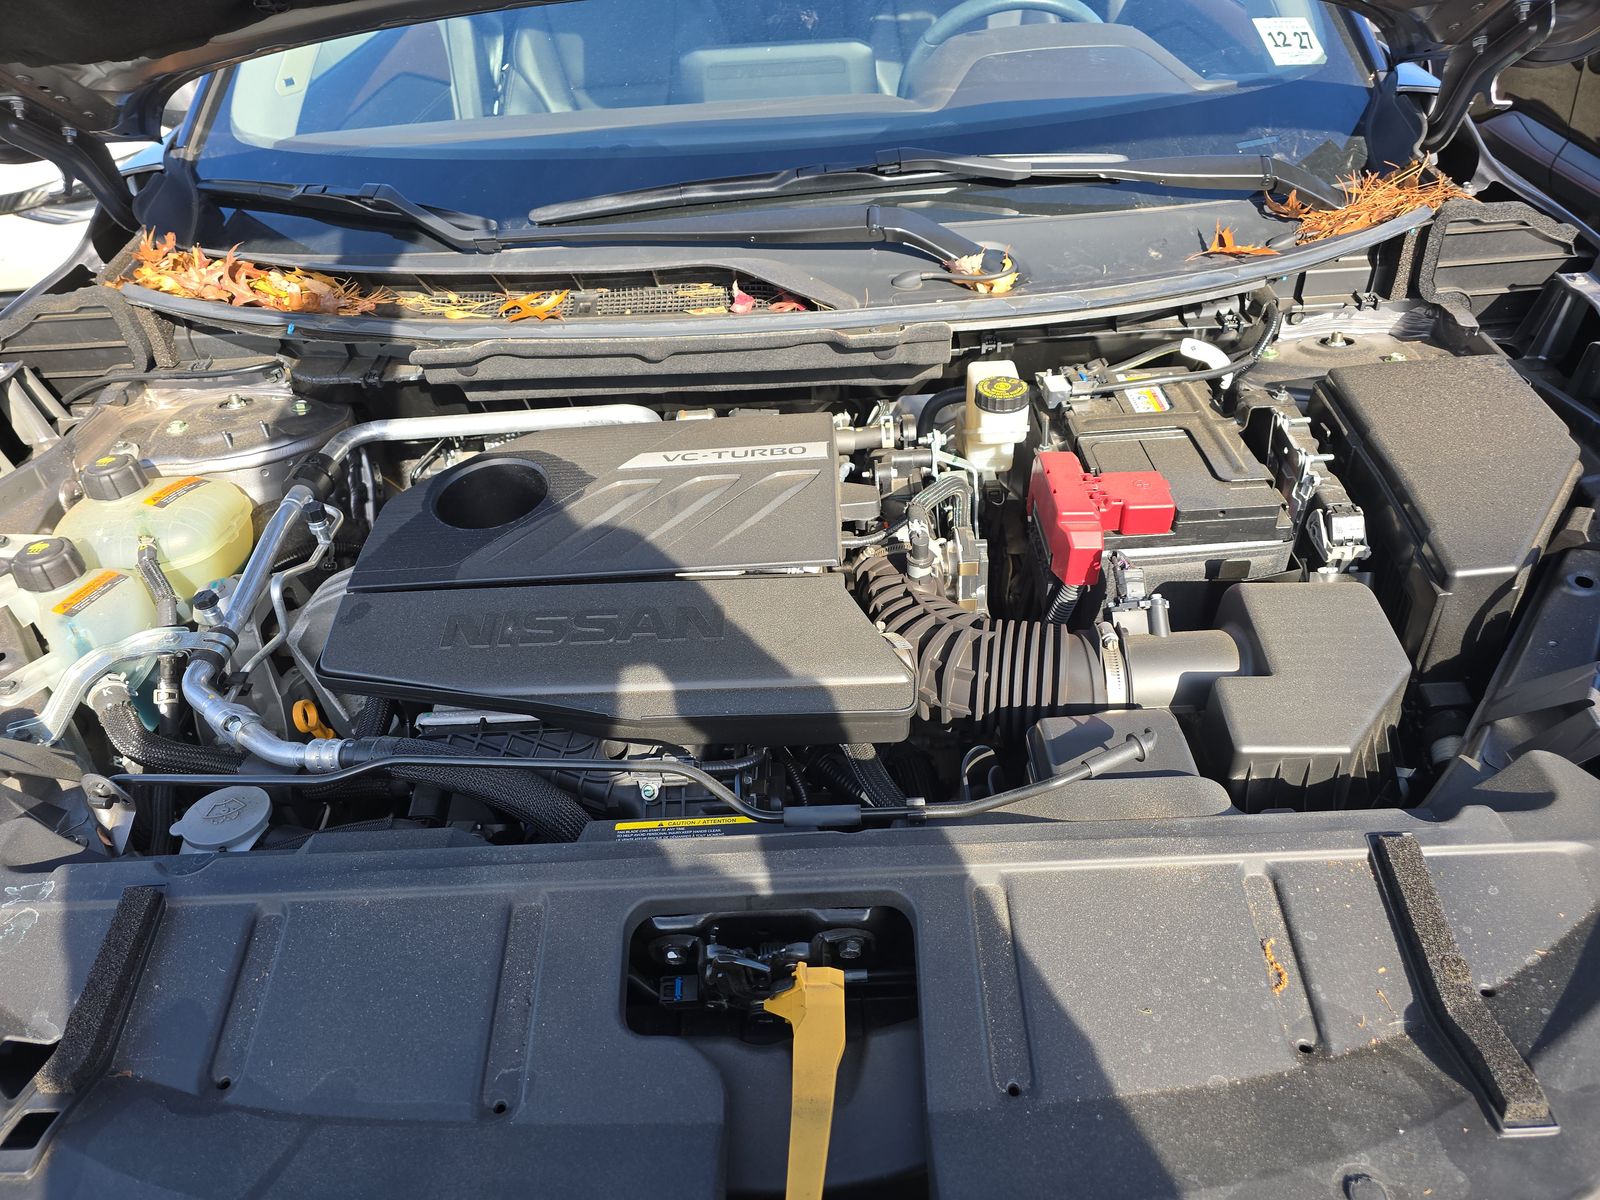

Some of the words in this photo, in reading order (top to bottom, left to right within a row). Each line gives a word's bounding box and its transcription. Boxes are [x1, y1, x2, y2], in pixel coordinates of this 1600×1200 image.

[1267, 31, 1292, 48] 12
[1293, 31, 1314, 49] 27
[662, 445, 807, 463] VC-TURBO
[439, 606, 725, 649] NISSAN
